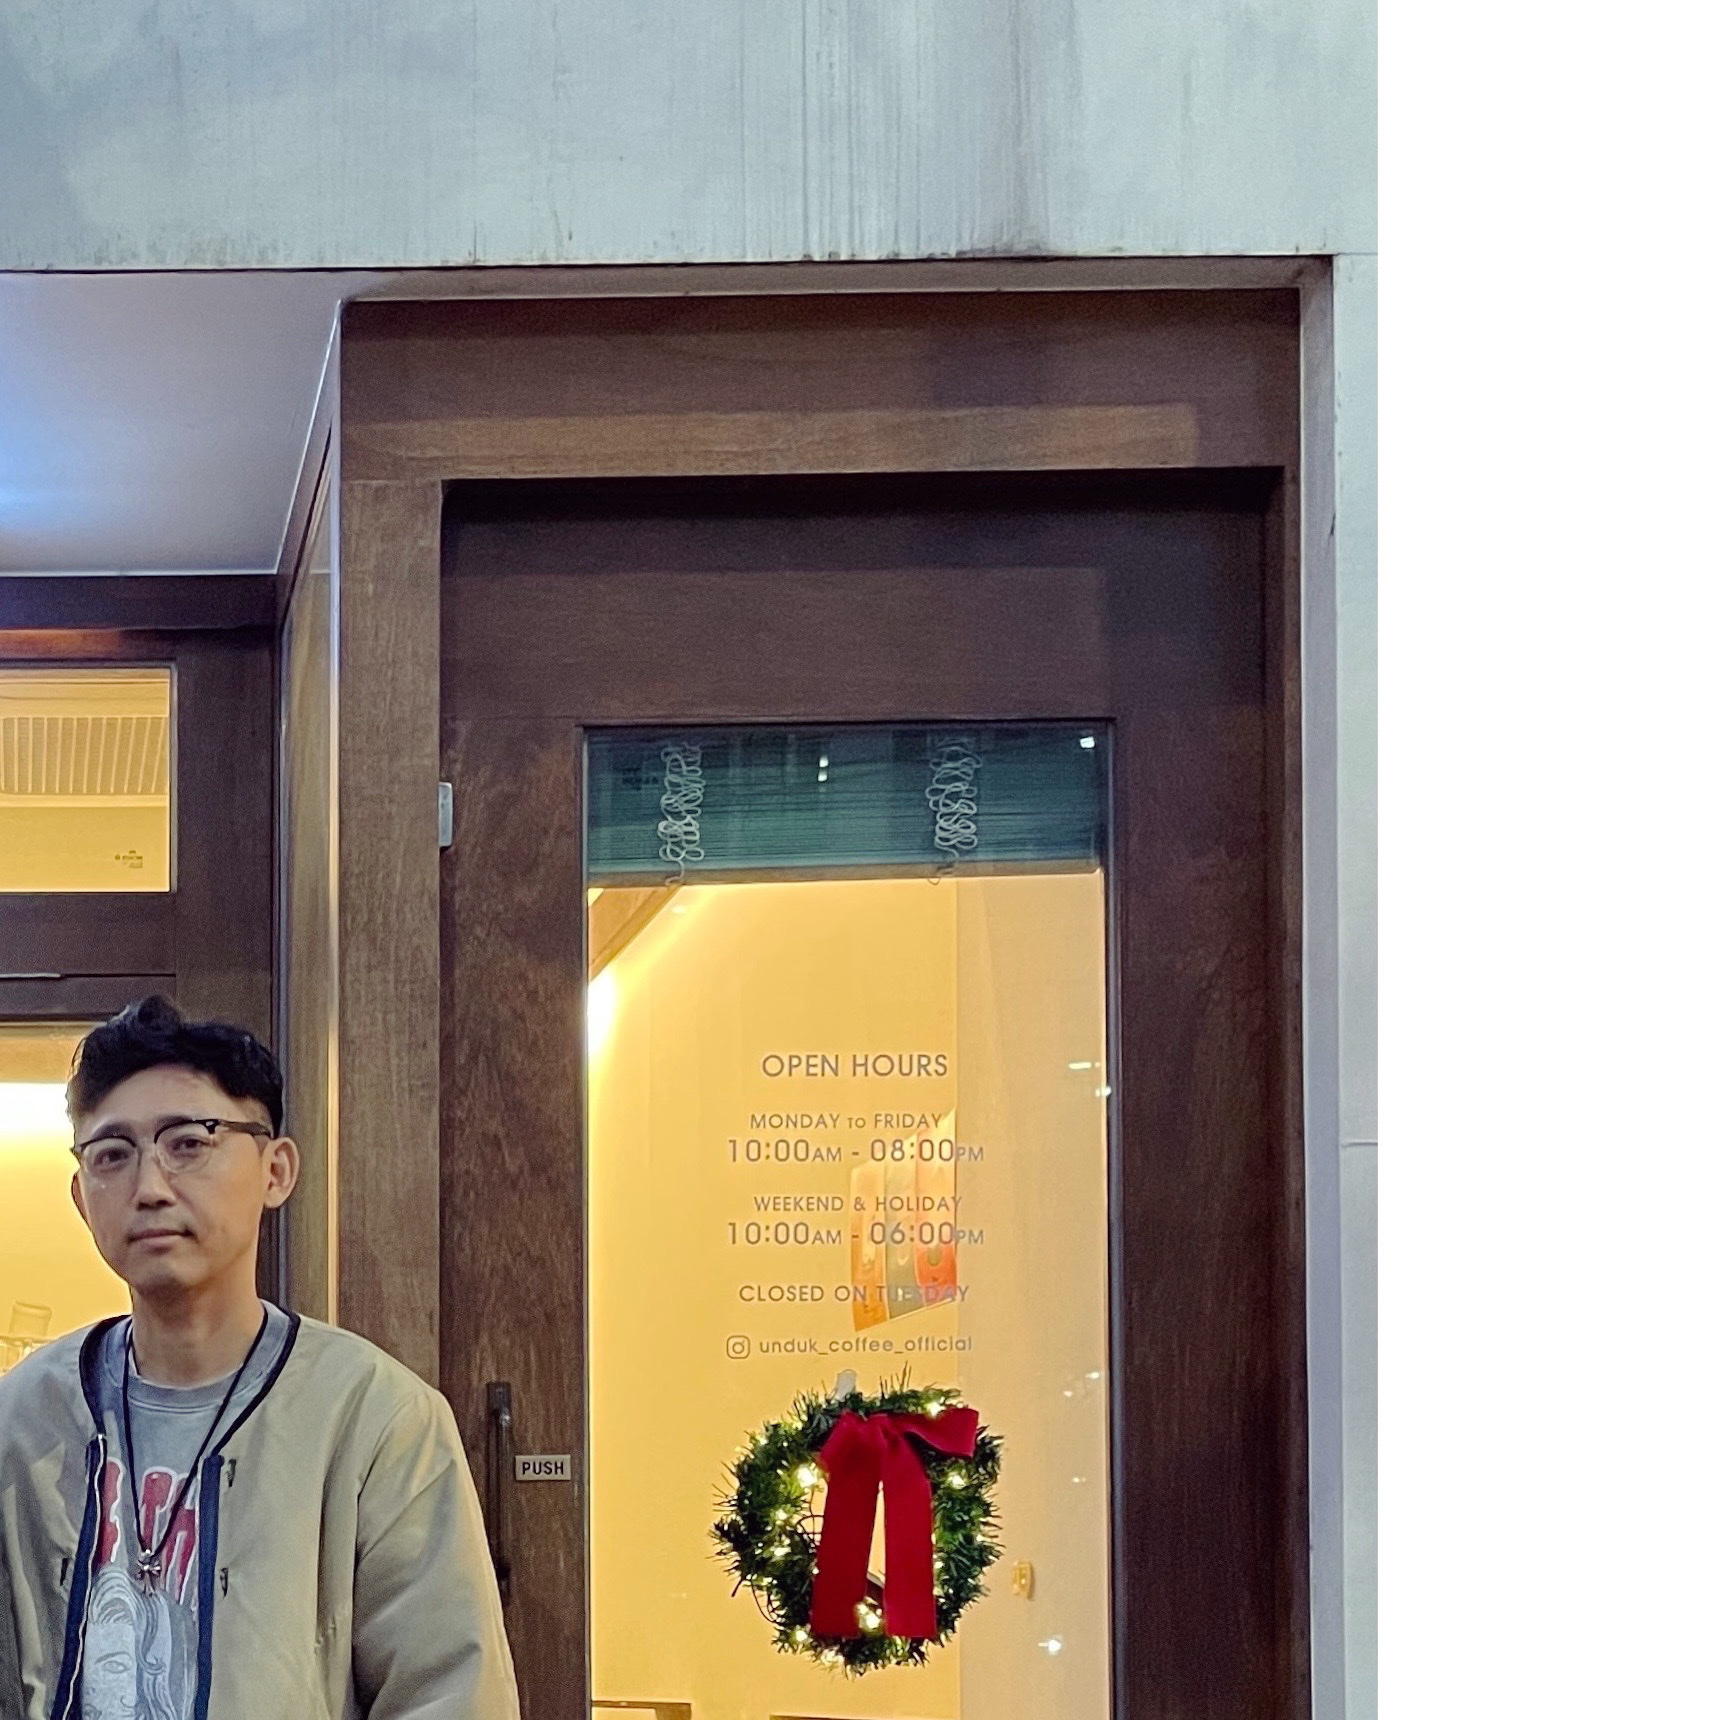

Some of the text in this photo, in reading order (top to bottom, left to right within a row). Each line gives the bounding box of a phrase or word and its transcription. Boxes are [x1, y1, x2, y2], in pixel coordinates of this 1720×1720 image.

[761, 1053, 948, 1078] OPEN HOURS
[749, 1112, 841, 1129] MONDAY
[873, 1112, 943, 1129] FRIDAY
[727, 1138, 843, 1163] 10:00AM
[870, 1138, 985, 1163] 08:00PM
[753, 1196, 963, 1212] WEEKEND & HOLIDAY
[727, 1221, 843, 1246] 10:00AM
[869, 1221, 985, 1246] 06:00PM
[738, 1285, 825, 1303] CLOSED
[834, 1285, 868, 1303] ON
[758, 1336, 973, 1356] unduk_coffee_official
[522, 1461, 564, 1475] PUSH
